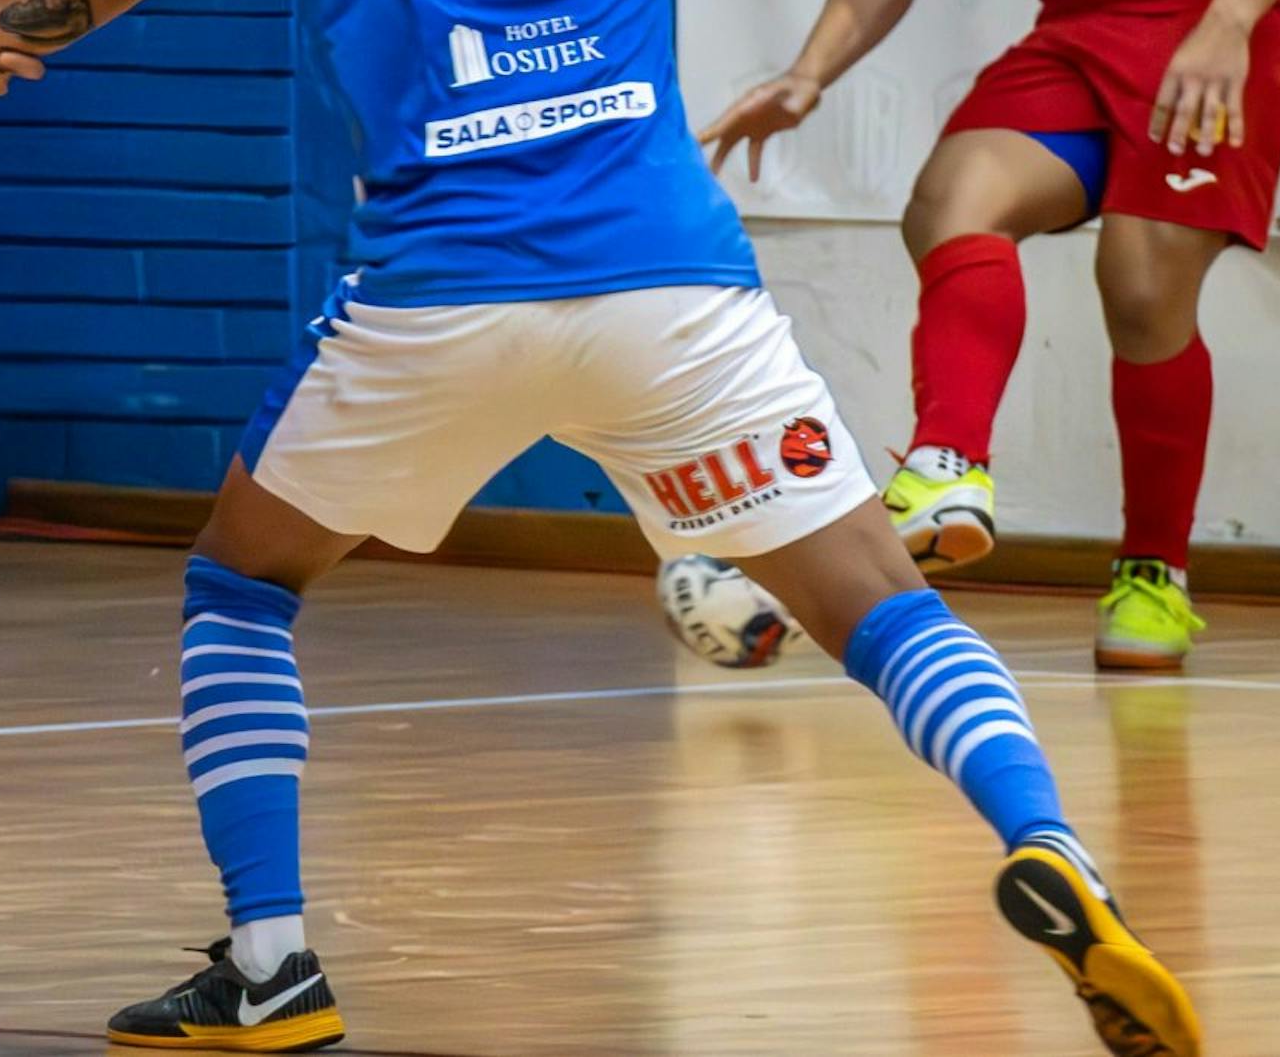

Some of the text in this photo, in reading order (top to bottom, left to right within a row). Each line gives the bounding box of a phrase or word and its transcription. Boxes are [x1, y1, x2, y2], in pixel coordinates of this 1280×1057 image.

[505, 15, 578, 43] HOTEL
[491, 36, 606, 77] OSIJEK
[436, 90, 635, 149] SALA SPORT
[643, 438, 777, 520] HELL
